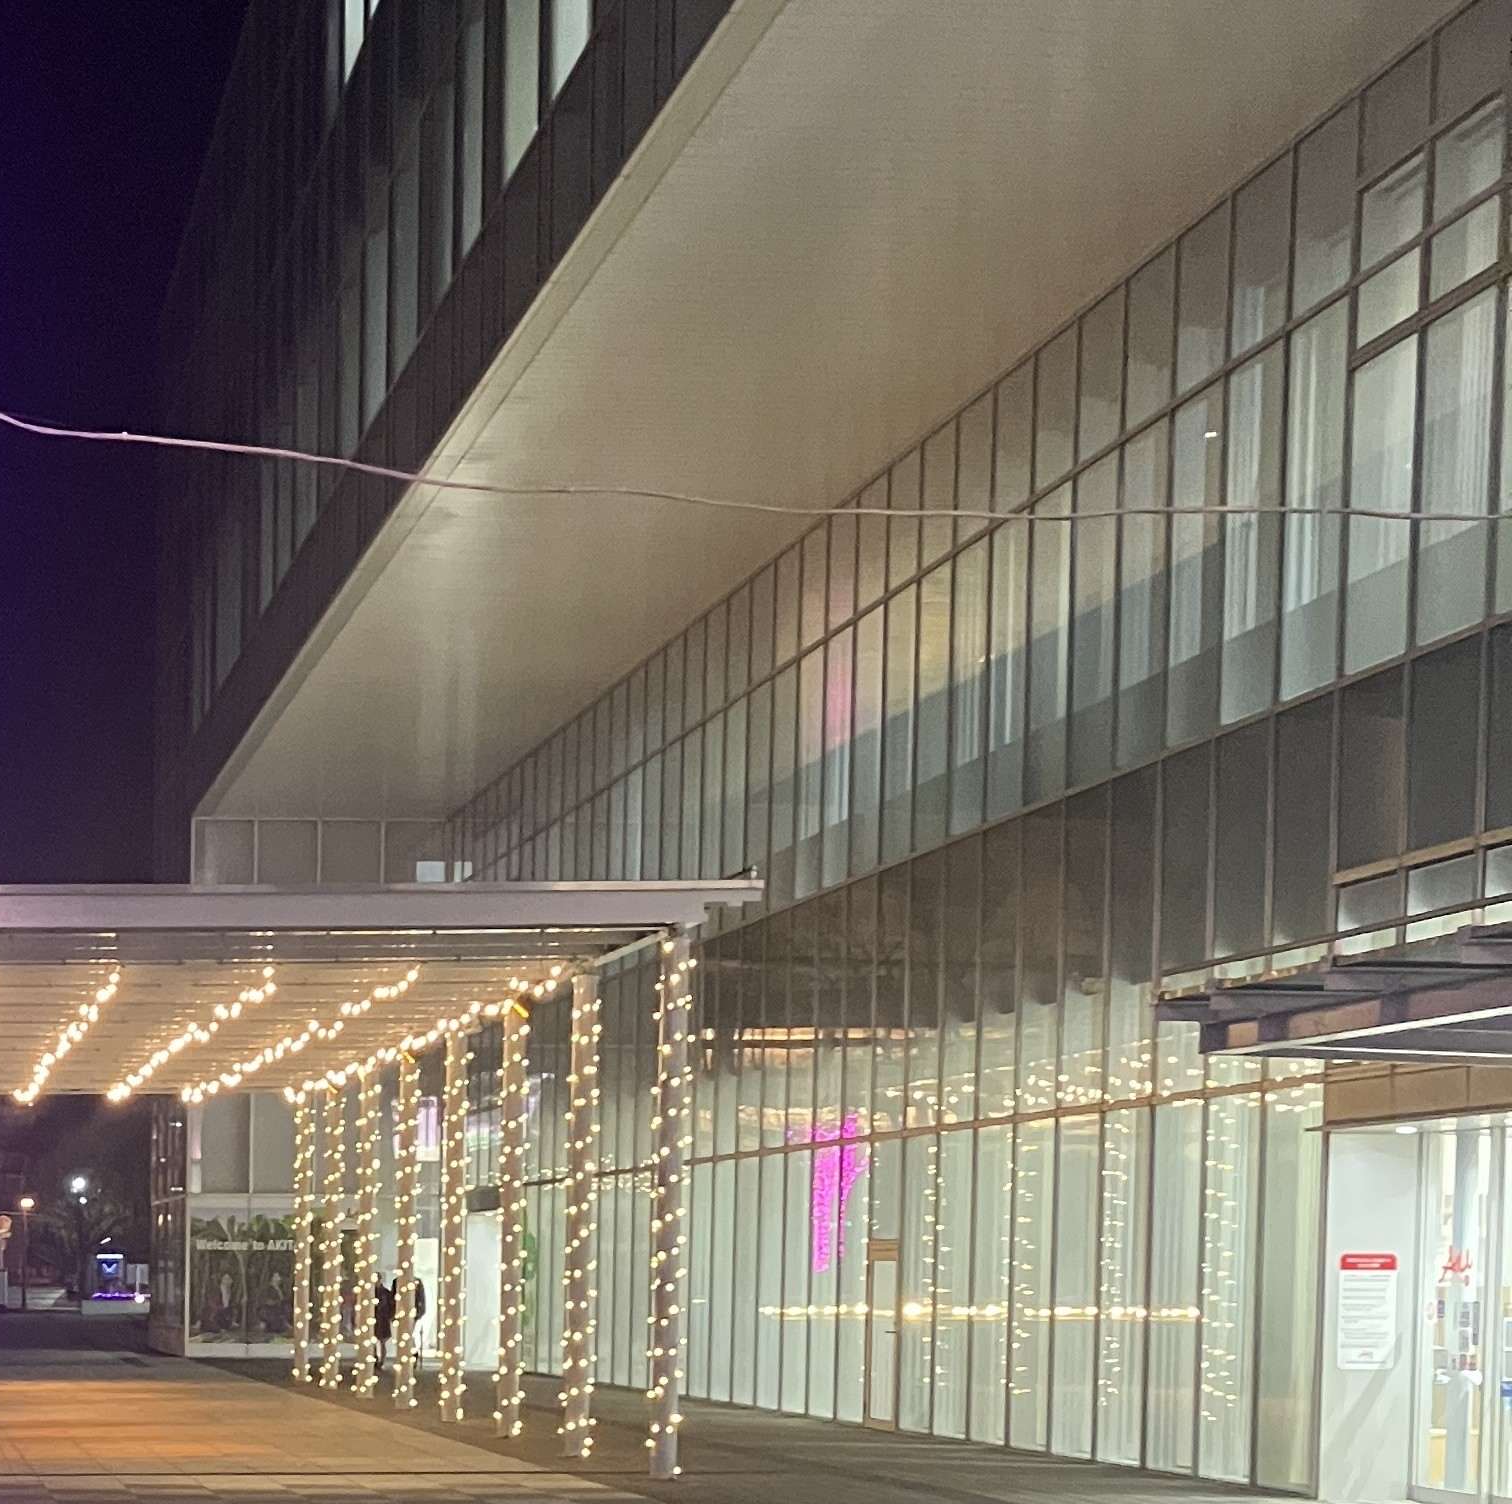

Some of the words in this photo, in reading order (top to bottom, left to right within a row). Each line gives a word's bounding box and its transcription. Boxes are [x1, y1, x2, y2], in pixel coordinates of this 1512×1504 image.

[196, 1239, 249, 1251] Welcome
[253, 1239, 265, 1251] to
[266, 1239, 297, 1251] AKIT
